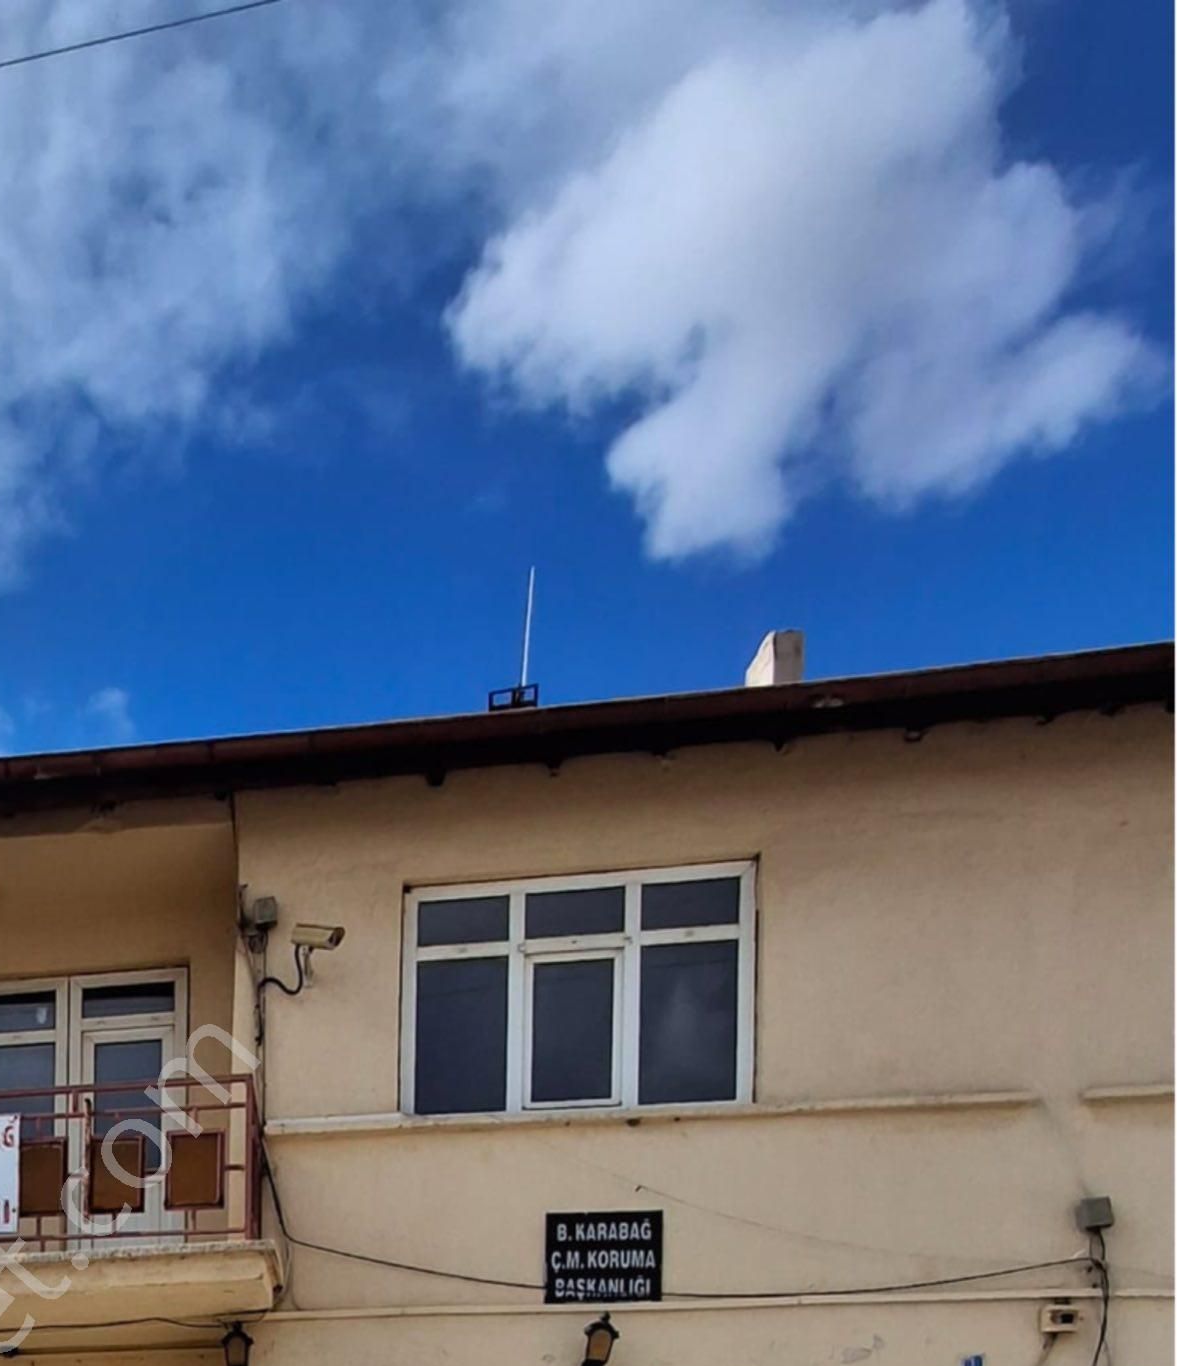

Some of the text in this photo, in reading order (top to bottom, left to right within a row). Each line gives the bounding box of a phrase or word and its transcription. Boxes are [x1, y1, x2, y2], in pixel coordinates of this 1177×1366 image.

[556, 1218, 652, 1242] B. KARABAĞ
[586, 1249, 657, 1269] KORUMA
